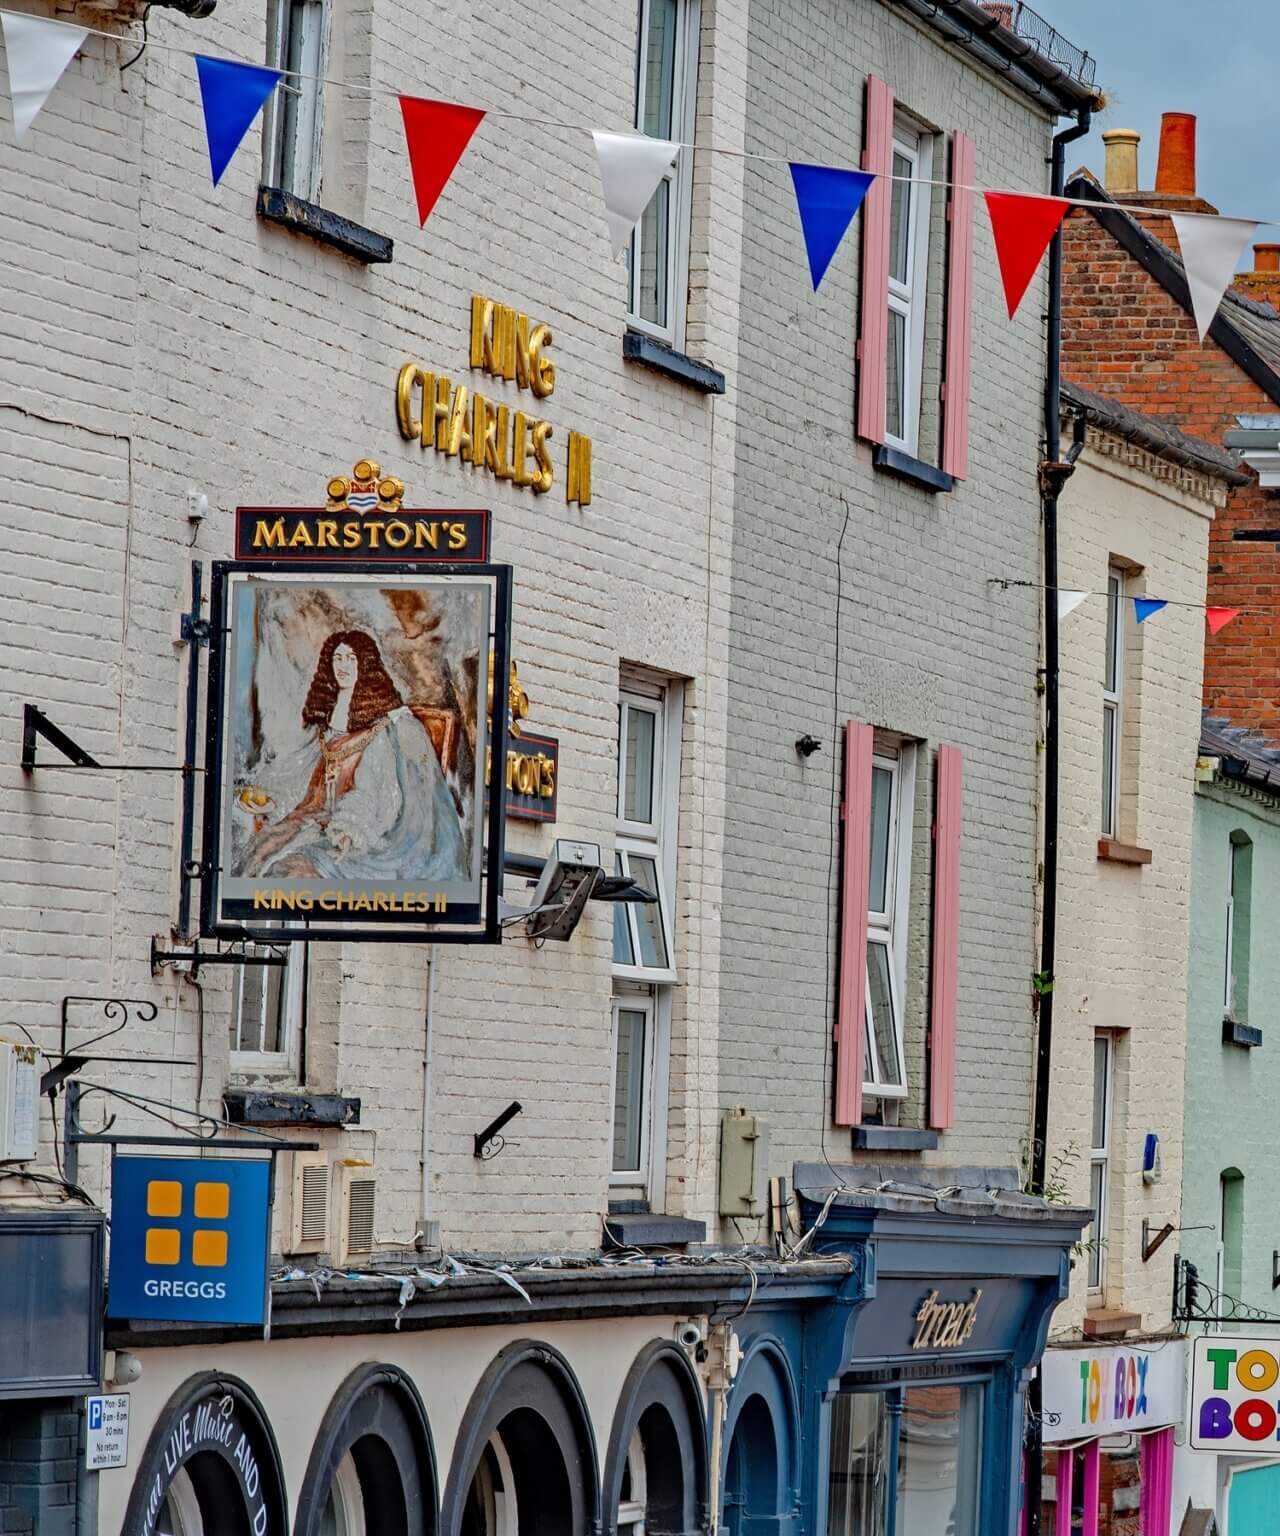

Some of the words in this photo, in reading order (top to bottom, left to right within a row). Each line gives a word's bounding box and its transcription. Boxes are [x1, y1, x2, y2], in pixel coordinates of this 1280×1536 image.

[470, 294, 556, 398] KING
[396, 362, 554, 493] CHARLES
[567, 431, 592, 505] II
[252, 519, 469, 550] MARSTON'S
[253, 889, 314, 910] KING
[319, 890, 431, 912] CHARLES
[434, 892, 447, 913] II
[144, 1279, 226, 1299] GREGGS
[1080, 1357, 1110, 1424] TOY
[1114, 1355, 1149, 1420] BOX
[164, 1412, 192, 1475] LIVE
[193, 1402, 234, 1447] Music
[234, 1432, 259, 1498] AND
